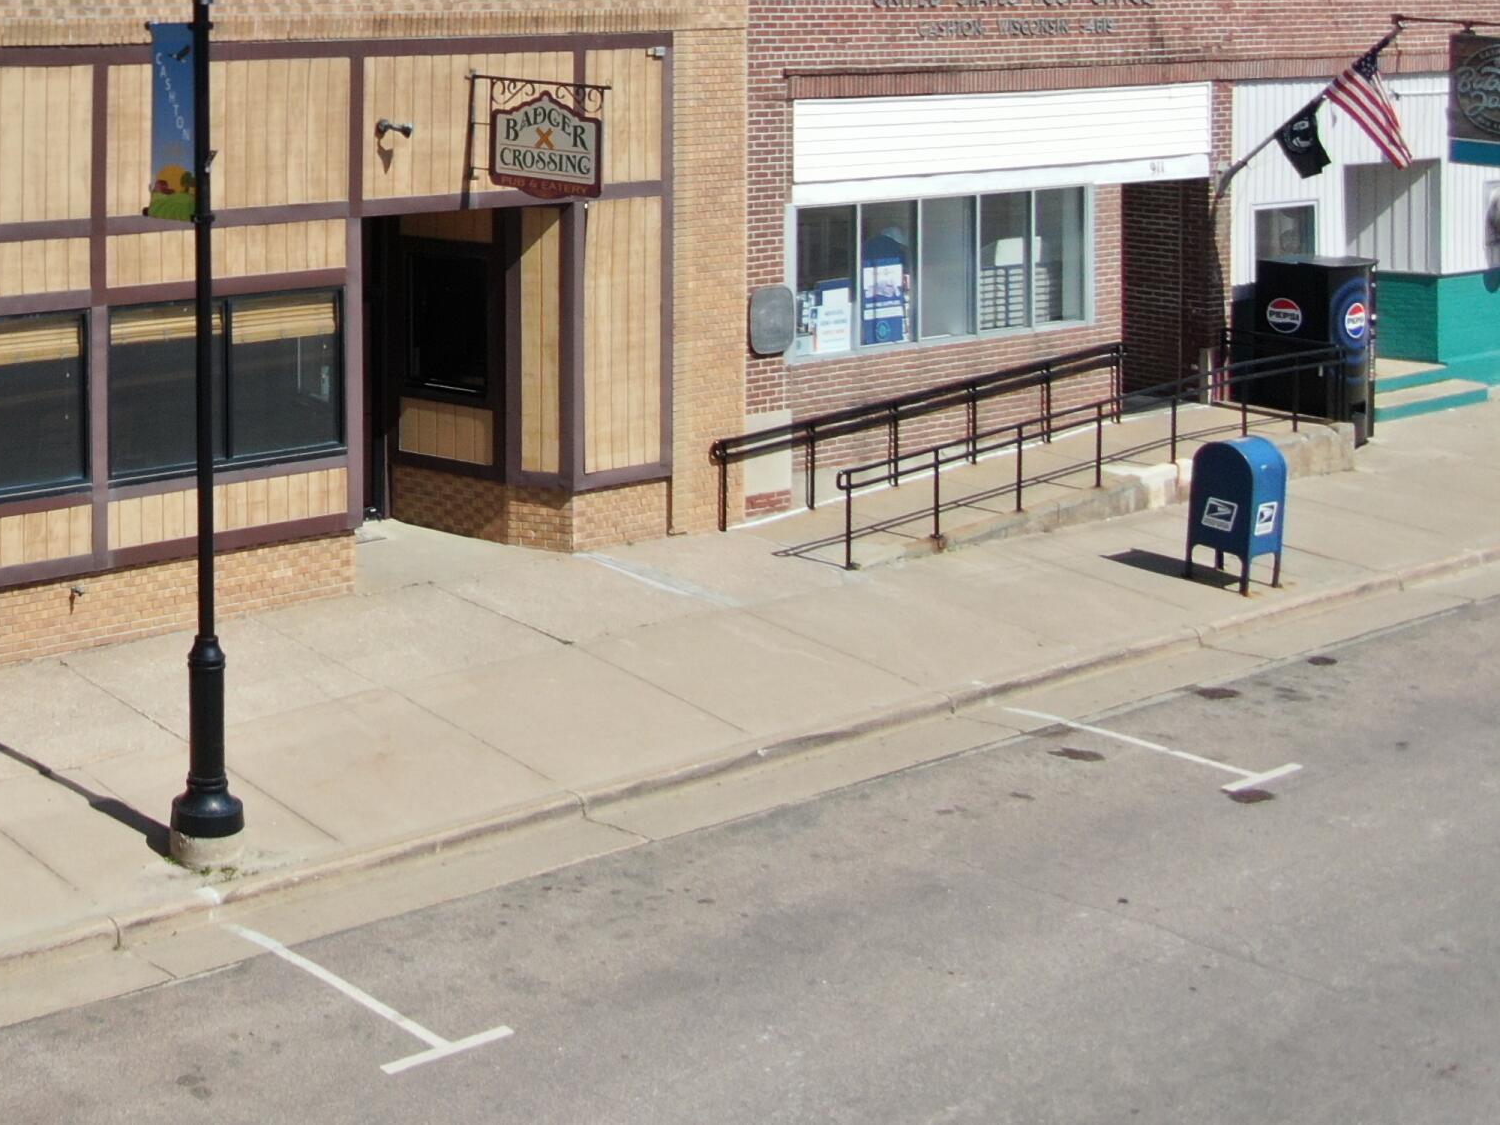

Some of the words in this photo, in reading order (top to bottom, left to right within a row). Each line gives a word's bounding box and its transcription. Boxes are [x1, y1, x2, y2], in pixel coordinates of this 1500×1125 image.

[155, 52, 191, 141] CASHTON
[504, 106, 588, 150] BADGER
[500, 146, 591, 175] CROSSING
[501, 176, 526, 187] PUB
[541, 181, 589, 195] EATERY
[1268, 309, 1300, 322] PEPSI
